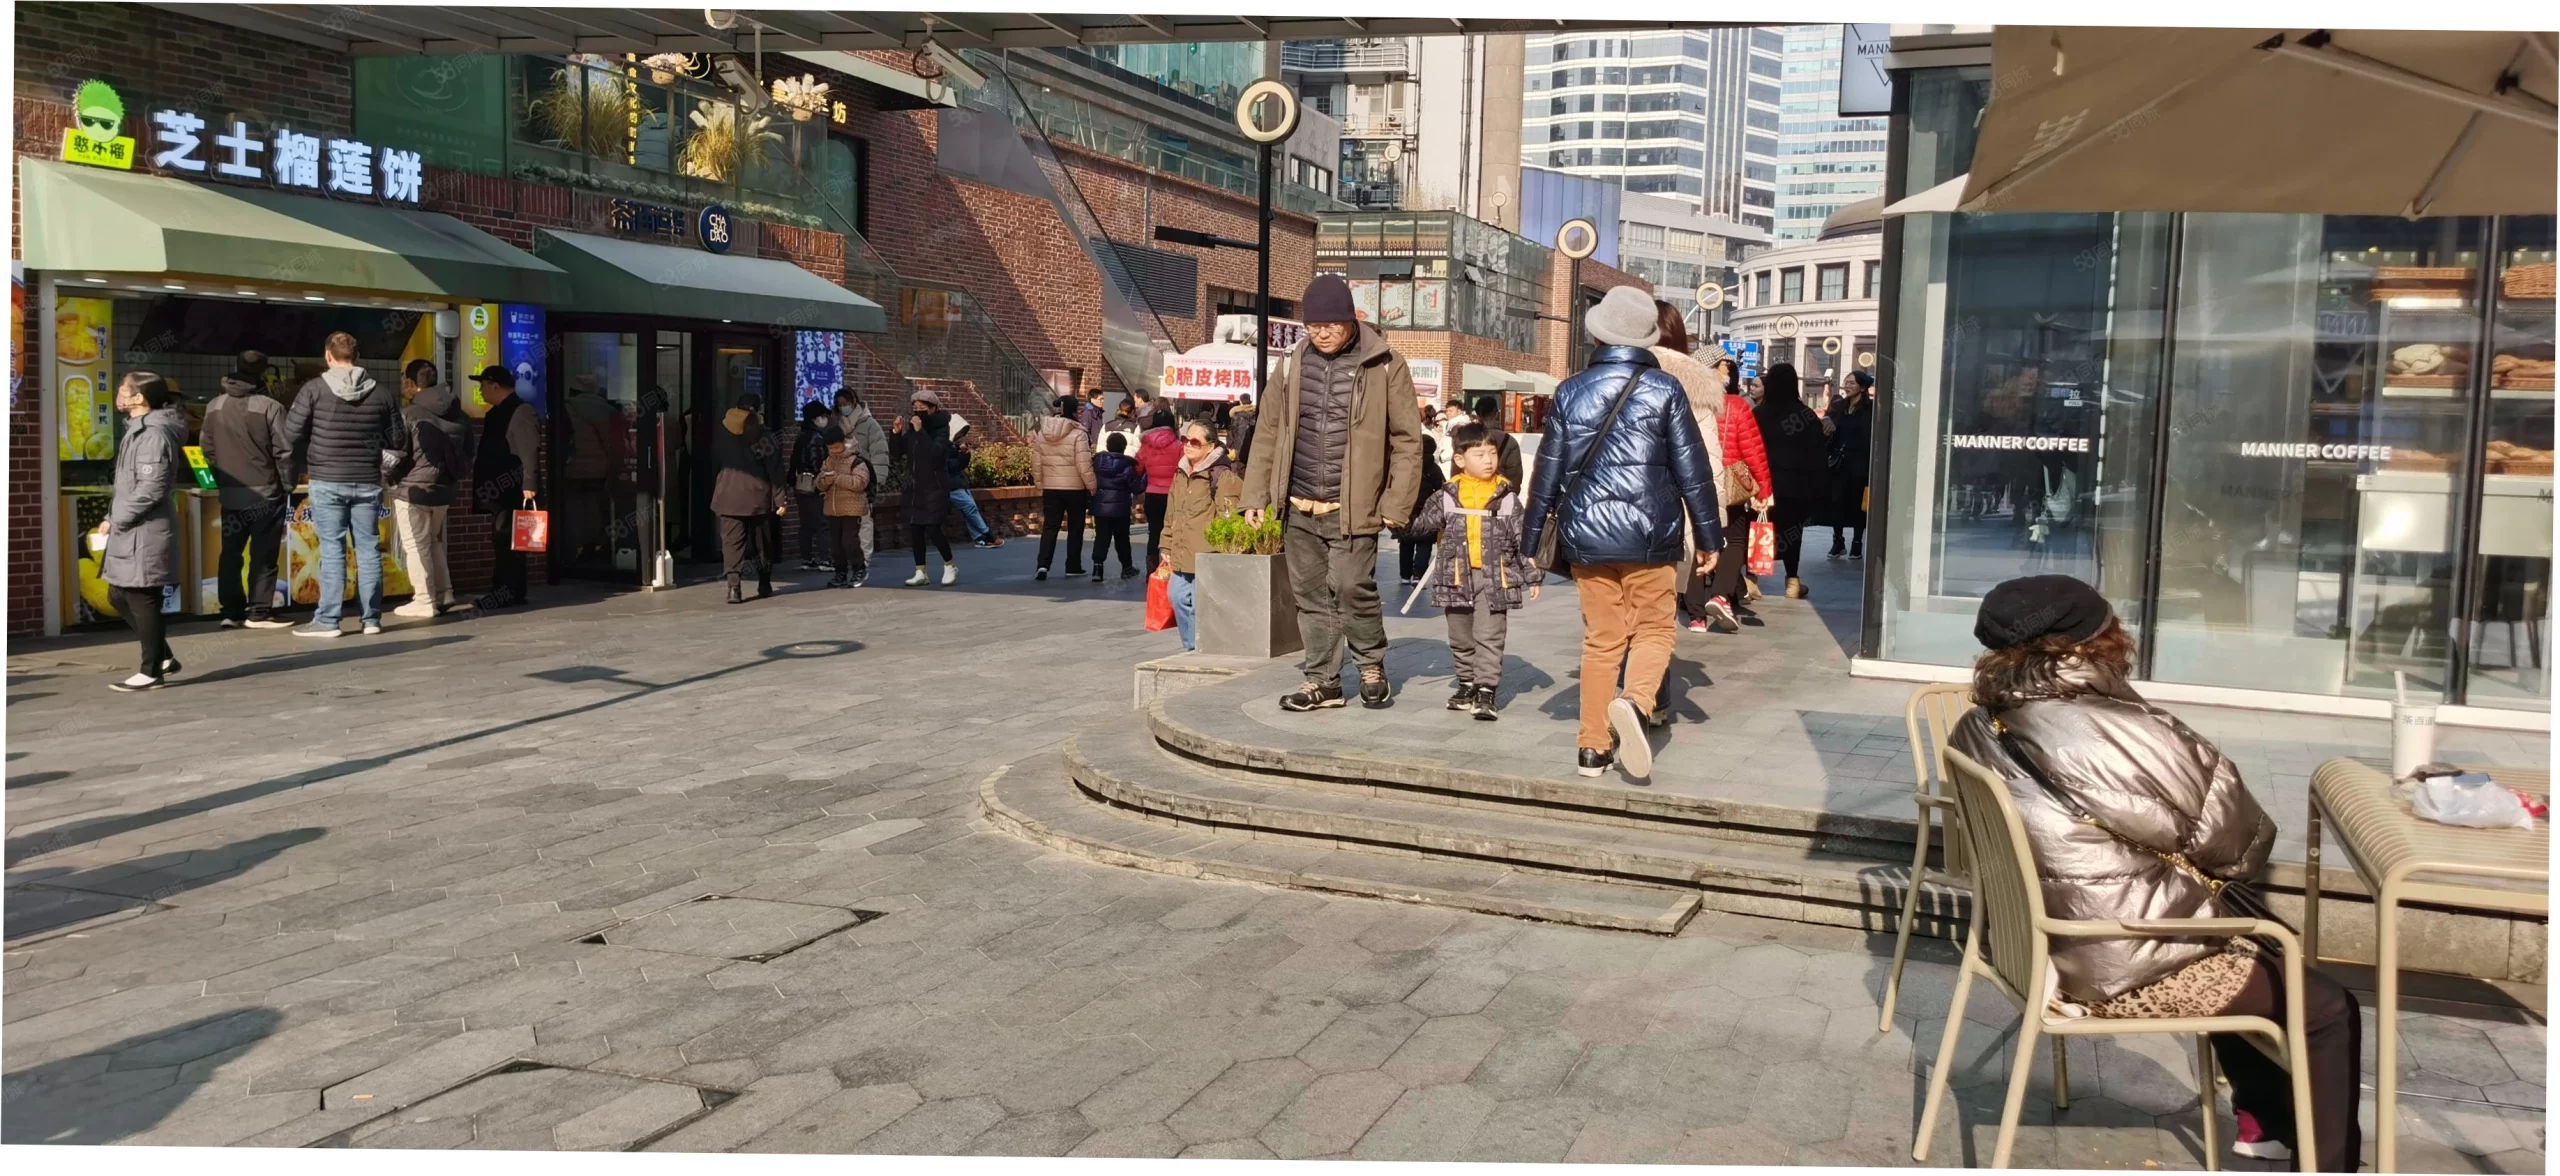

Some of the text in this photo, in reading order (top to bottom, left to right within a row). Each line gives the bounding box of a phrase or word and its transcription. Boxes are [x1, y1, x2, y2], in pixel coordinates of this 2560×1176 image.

[153, 109, 422, 203] 芝士榴莲饼
[709, 213, 727, 226] CHA
[710, 231, 729, 243] DAO
[1175, 366, 1251, 389] 脆皮烤肠
[1411, 366, 1439, 379] 榨果汁
[2068, 389, 2081, 400] 拉
[1953, 434, 2090, 452] MANNER COFFEE
[2241, 441, 2393, 460] MANNER COFFEE
